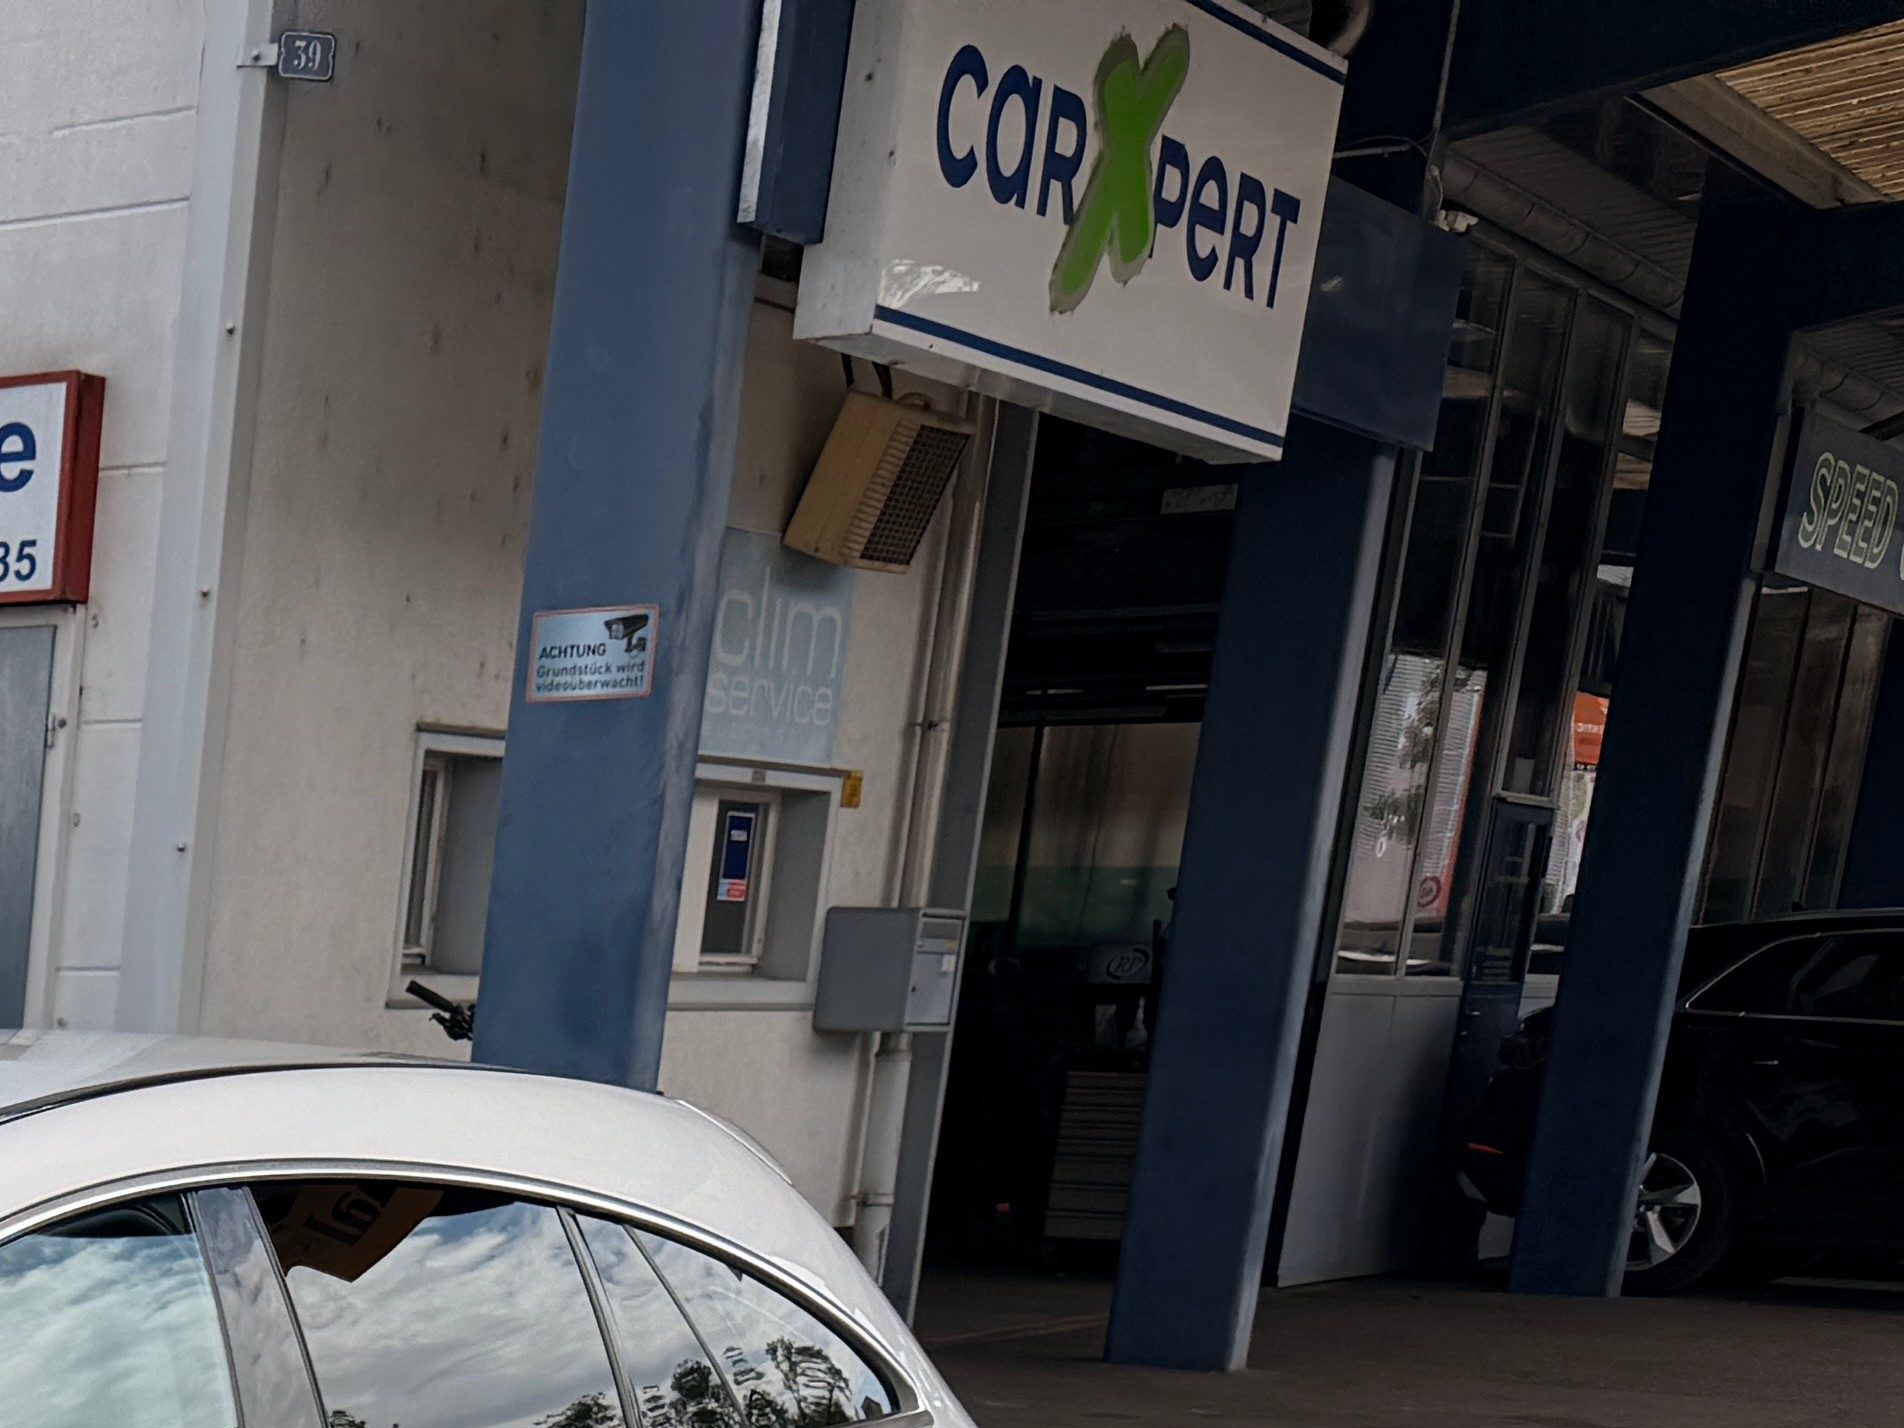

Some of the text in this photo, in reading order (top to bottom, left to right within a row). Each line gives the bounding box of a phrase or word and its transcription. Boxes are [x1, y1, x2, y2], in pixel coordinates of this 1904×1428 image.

[293, 40, 321, 70] 39
[1798, 452, 1898, 568] SPEED
[715, 566, 842, 679] clim
[536, 659, 646, 678] Grundstück wird
[539, 643, 607, 659] ACHTUNG
[705, 672, 834, 727] service
